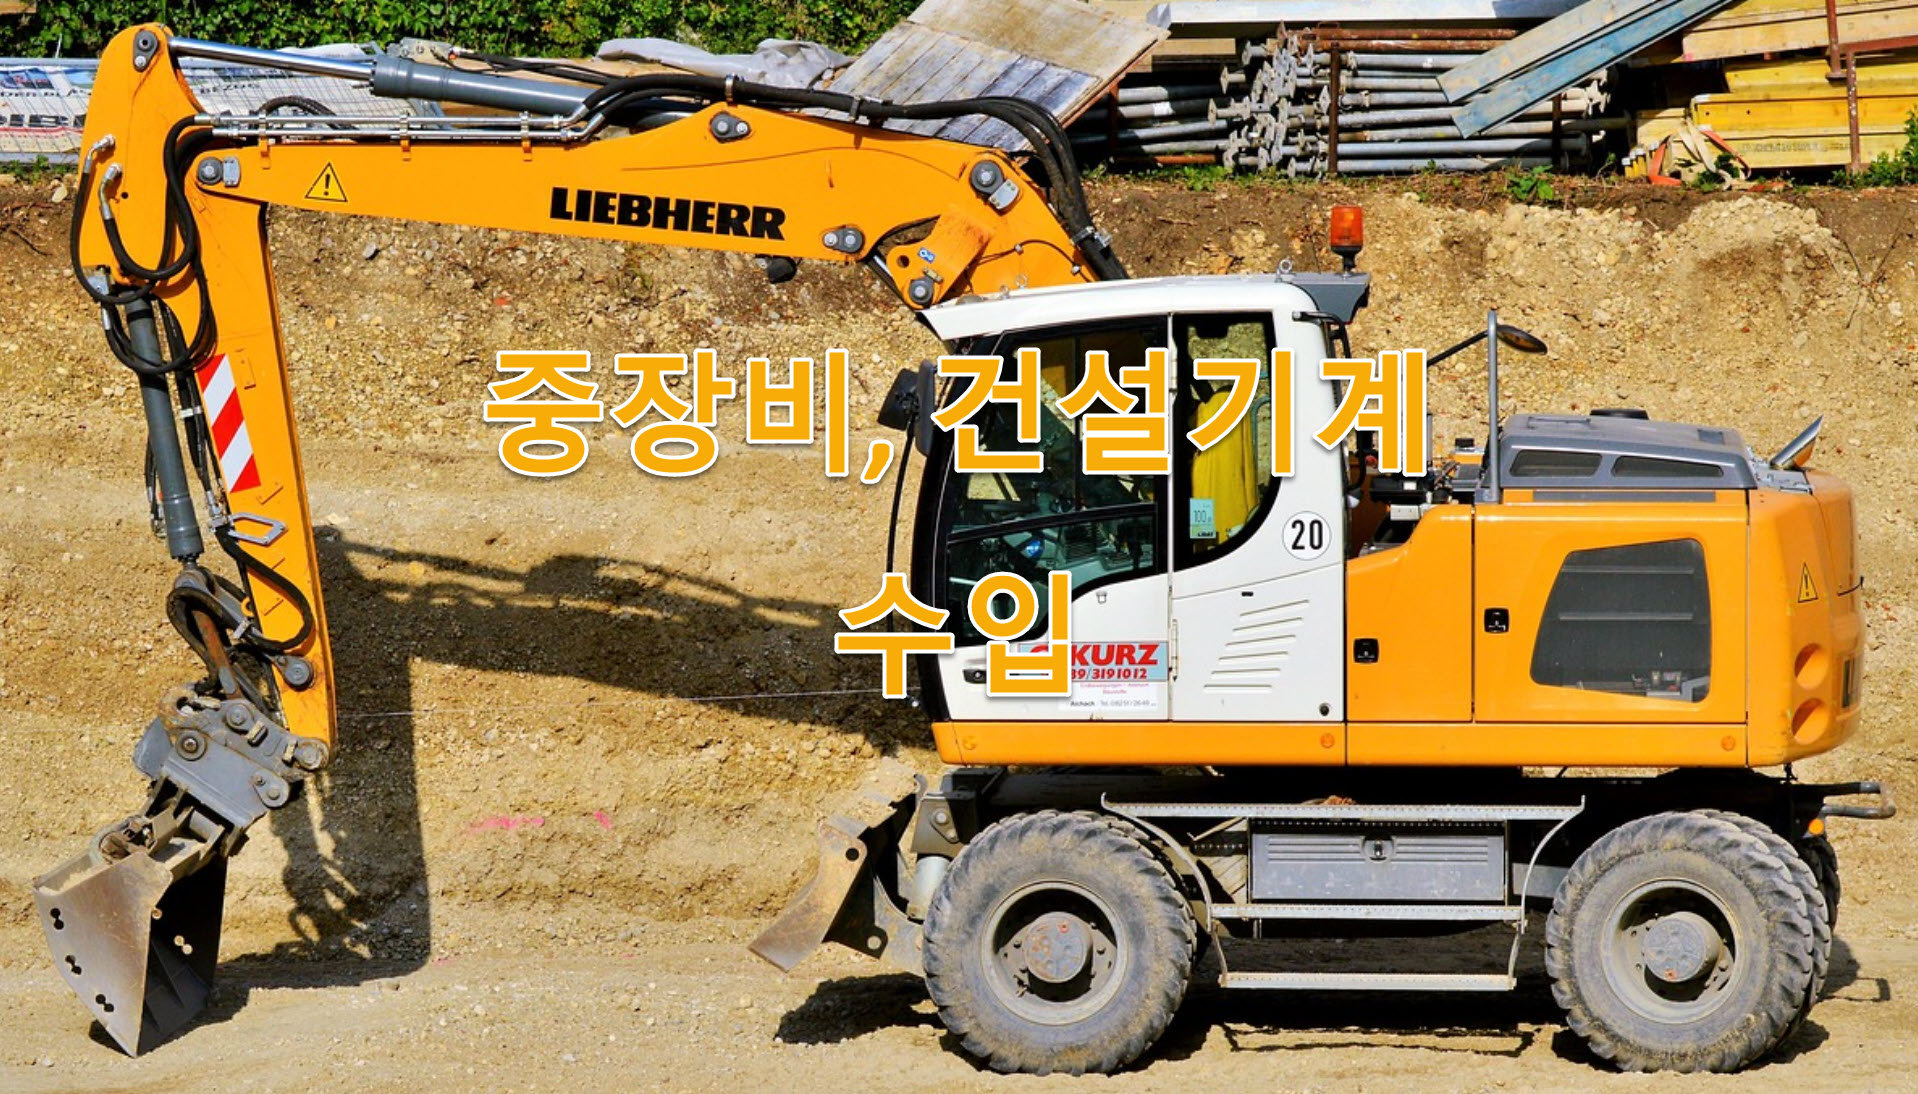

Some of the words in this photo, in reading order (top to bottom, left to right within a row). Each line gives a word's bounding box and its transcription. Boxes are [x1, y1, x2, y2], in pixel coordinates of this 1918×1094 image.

[551, 187, 785, 241] LIEBHERR
[1291, 519, 1324, 551] 20
[1071, 644, 1160, 666] KURZ
